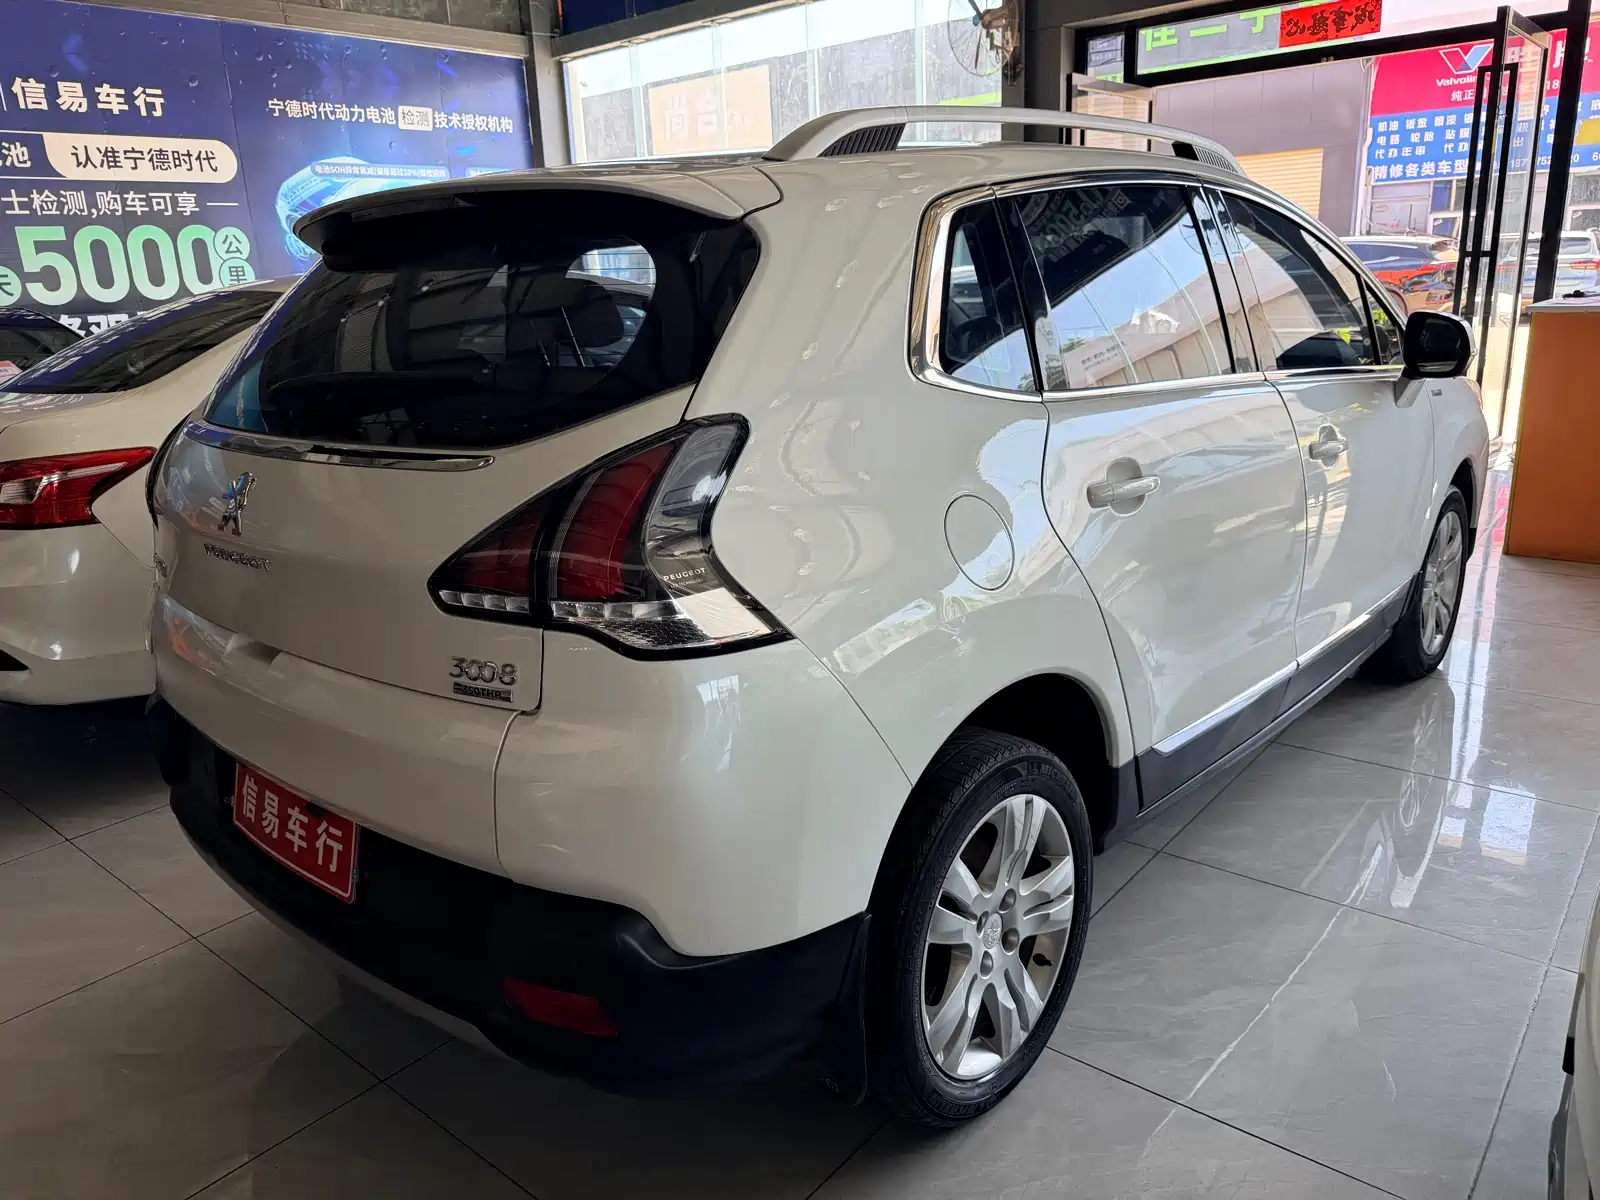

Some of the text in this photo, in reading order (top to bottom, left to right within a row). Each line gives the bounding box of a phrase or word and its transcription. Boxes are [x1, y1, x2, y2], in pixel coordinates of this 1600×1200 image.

[12, 77, 165, 117] 信易车行
[0, 141, 218, 172] 池 认准宁德时代
[14, 224, 216, 306] 5000
[663, 567, 706, 582] PEUGEOT
[449, 655, 518, 685] 3008
[242, 773, 344, 873] 信易车行
